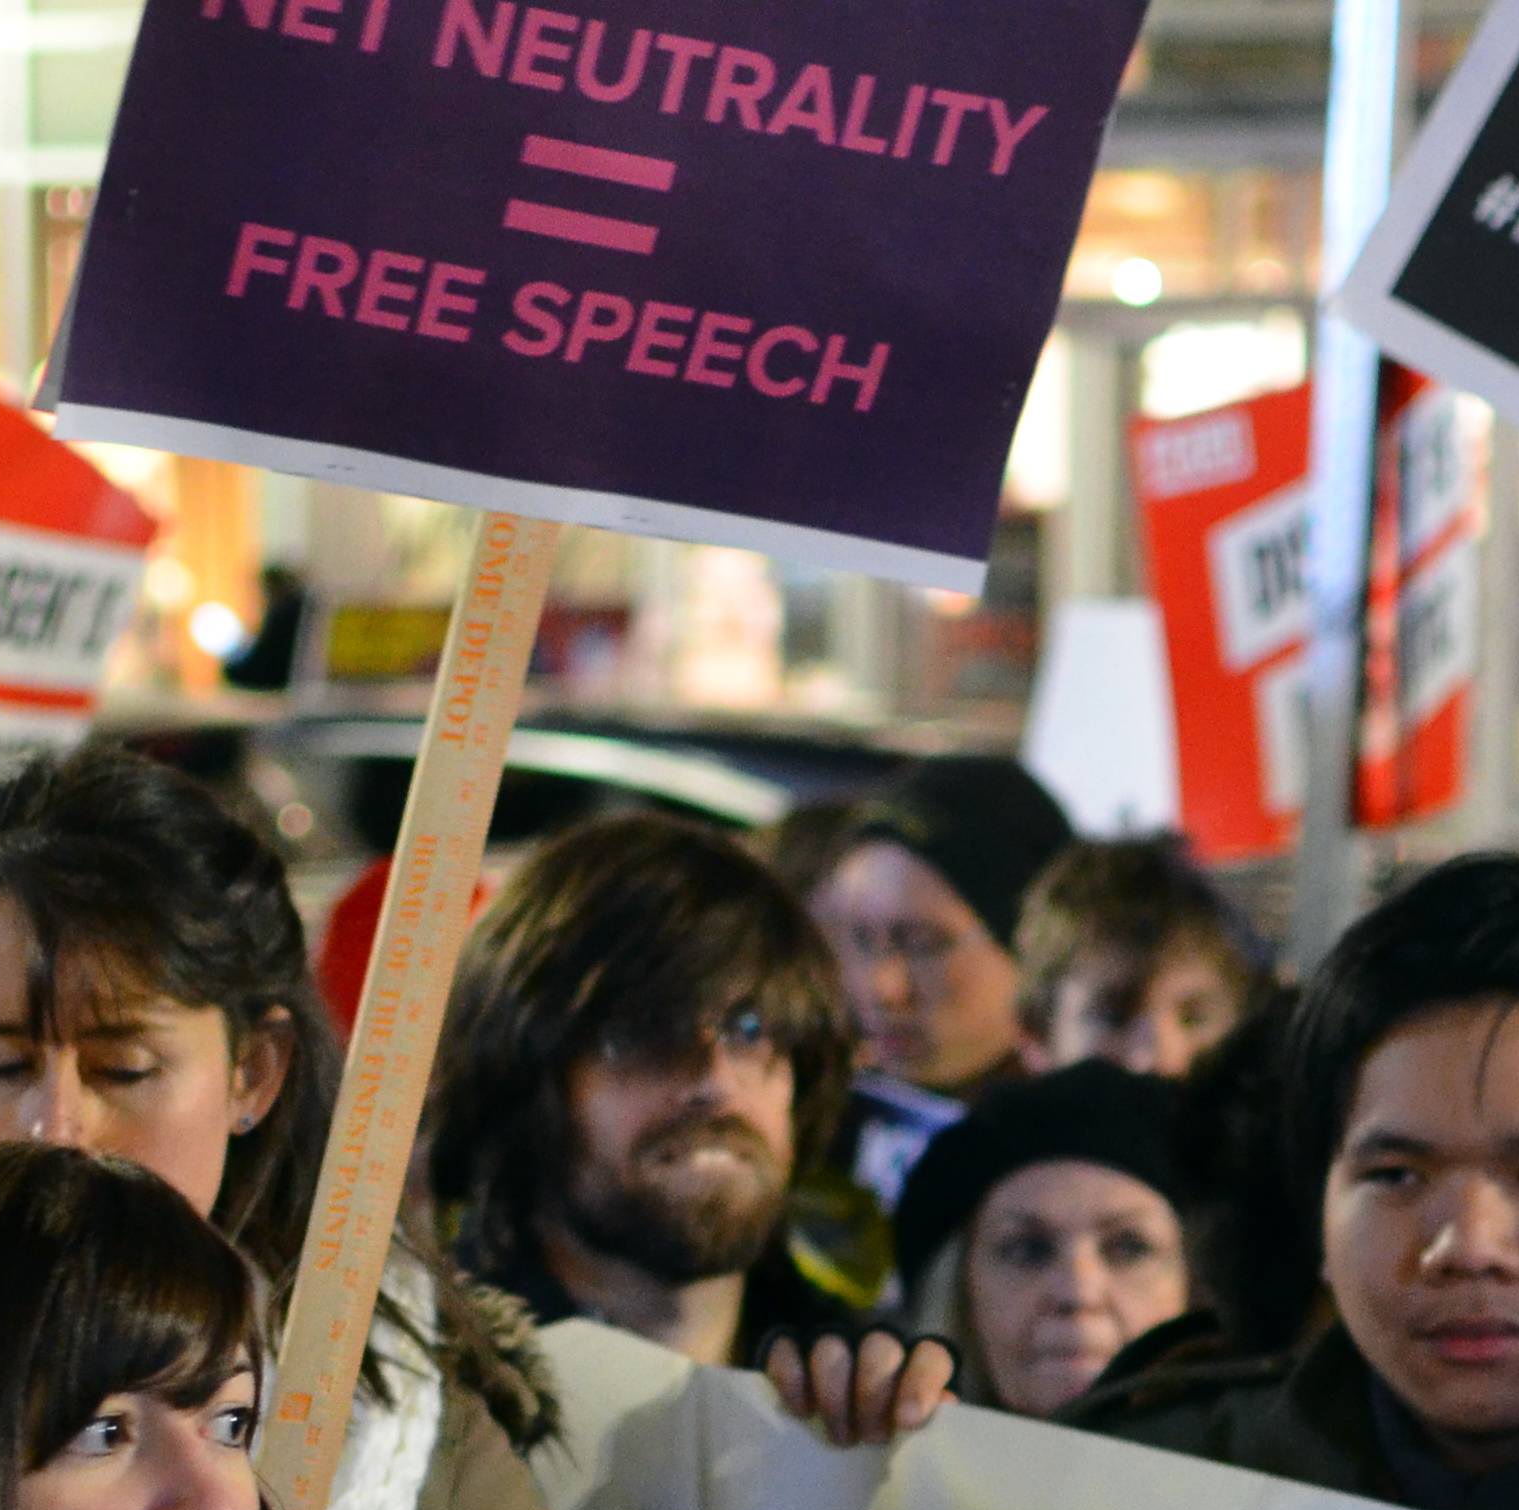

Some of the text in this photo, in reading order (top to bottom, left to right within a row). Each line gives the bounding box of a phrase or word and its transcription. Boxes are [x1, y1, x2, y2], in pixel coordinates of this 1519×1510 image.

[202, 0, 1049, 177] ET NEUTRALITY
[224, 222, 892, 413] FREE SPEECH
[439, 618, 493, 748] DEPOT
[342, 1053, 386, 1156] FINEST
[315, 1163, 359, 1271] PAINTS
